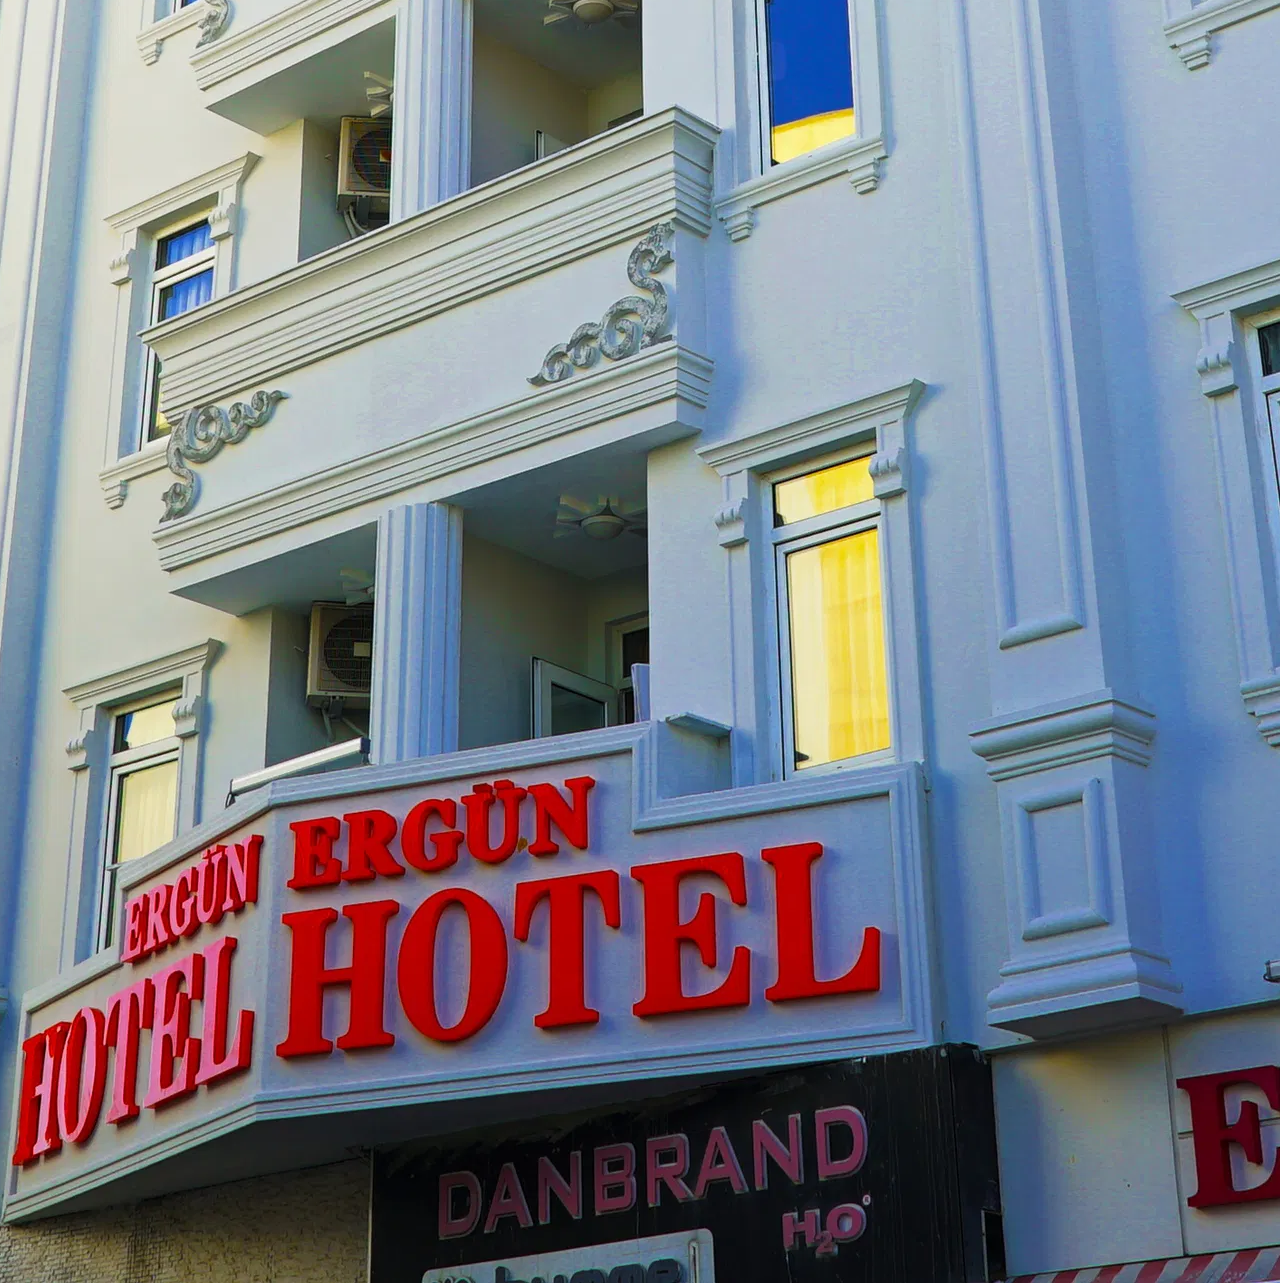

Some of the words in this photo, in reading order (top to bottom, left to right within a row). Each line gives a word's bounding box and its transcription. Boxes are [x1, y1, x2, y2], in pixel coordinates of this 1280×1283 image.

[122, 835, 264, 963] ERGÜN
[287, 776, 595, 891] ERGÜN
[276, 842, 881, 1059] HOTEL
[13, 937, 255, 1166] HOTEL
[438, 1105, 870, 1241] DANBRAND
